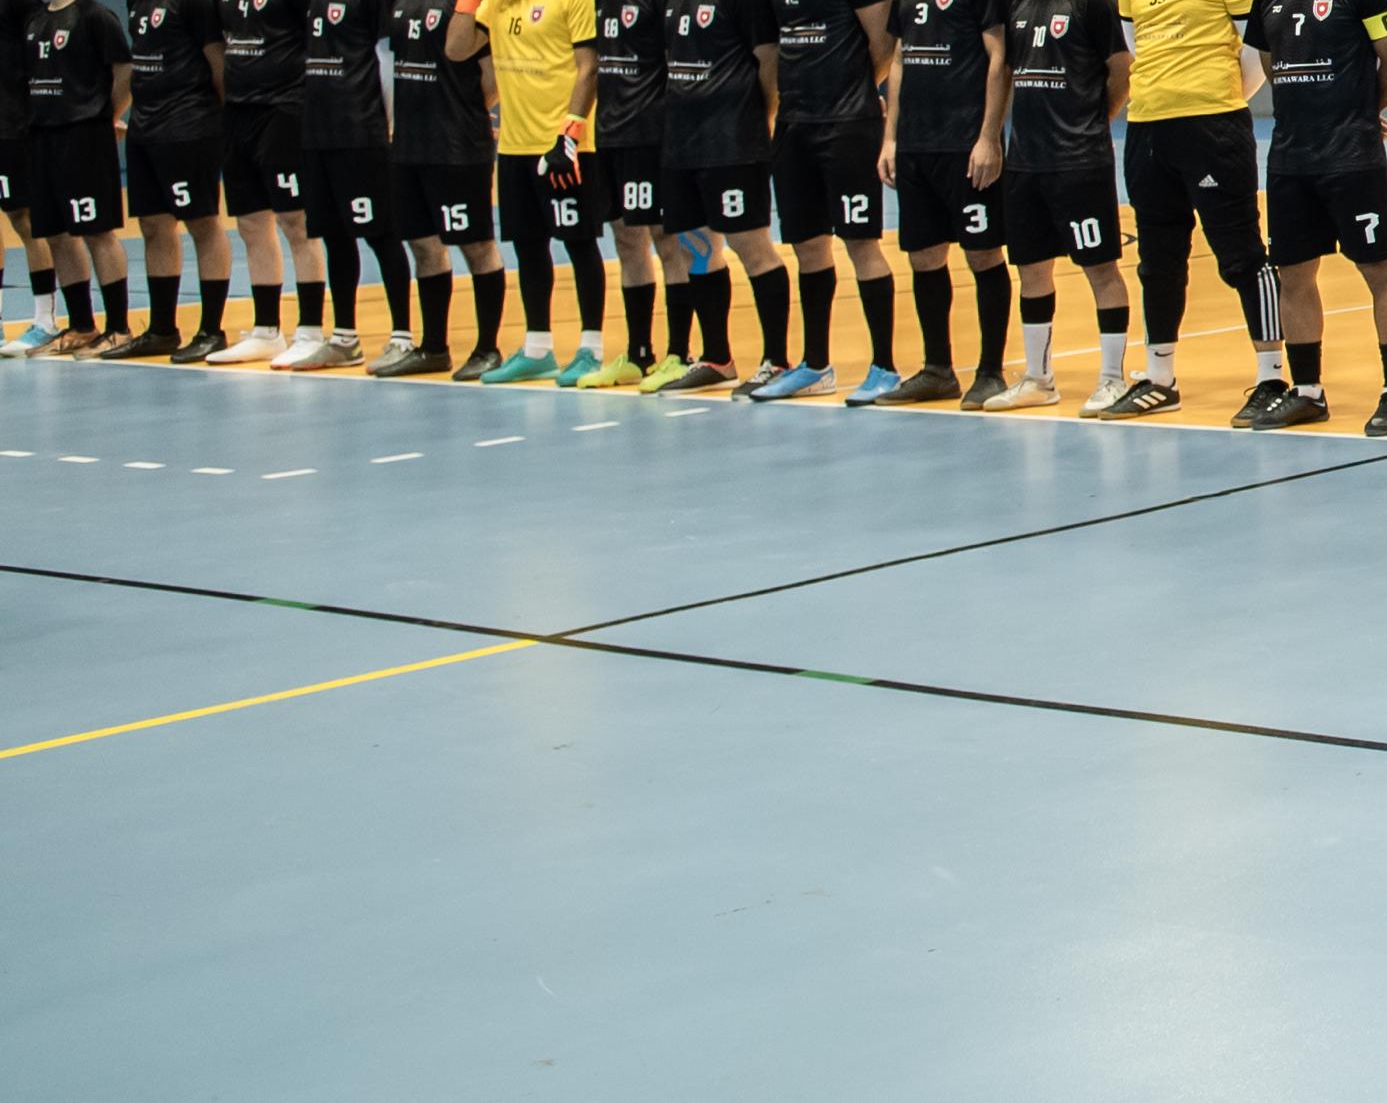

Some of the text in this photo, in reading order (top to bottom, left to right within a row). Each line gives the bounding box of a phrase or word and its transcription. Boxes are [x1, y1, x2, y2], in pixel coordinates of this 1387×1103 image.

[238, 0, 249, 18] 4
[914, 2, 929, 25] 3
[138, 16, 149, 35] 5
[312, 17, 323, 37] 9
[508, 17, 522, 36] 16
[1032, 25, 1047, 48] 10
[1292, 13, 1306, 36] 7
[1316, 74, 1335, 82] LLC
[171, 181, 191, 207] 5
[277, 173, 299, 197] 4
[623, 181, 652, 210] 88
[69, 197, 96, 223] 13
[351, 197, 373, 224] 9
[550, 198, 579, 227] 16
[722, 188, 744, 218] 8
[841, 194, 869, 224] 12
[441, 203, 469, 232] 15
[962, 203, 988, 234] 3
[1355, 212, 1380, 244] 7
[1069, 217, 1102, 250] 10
